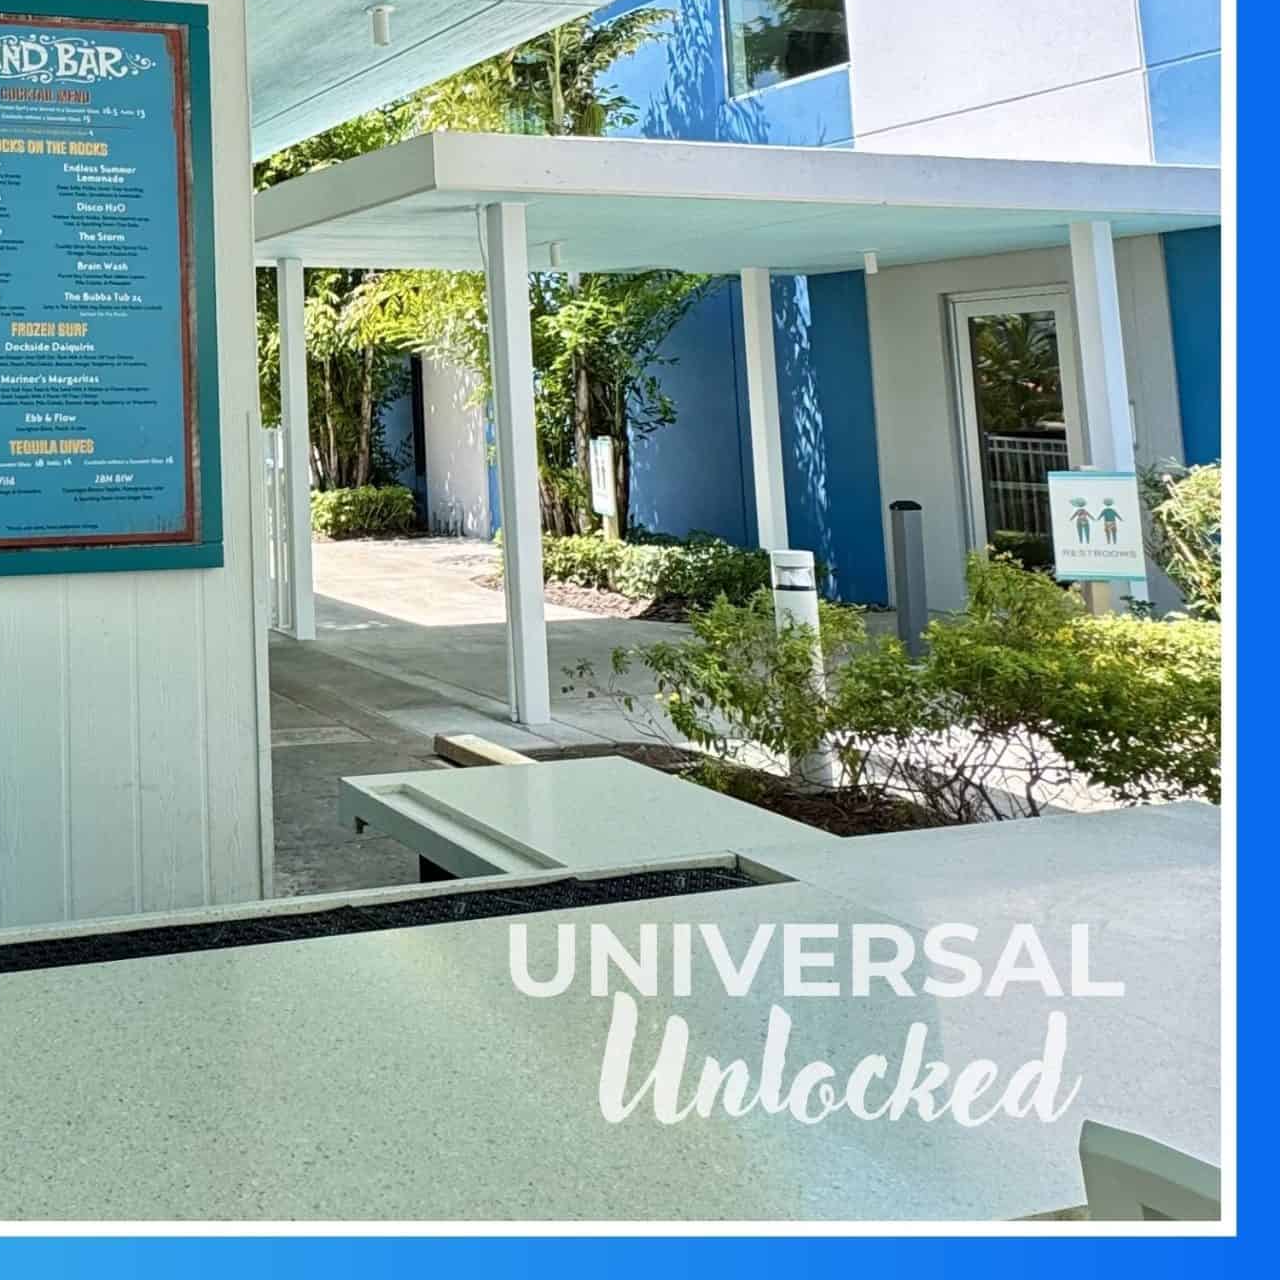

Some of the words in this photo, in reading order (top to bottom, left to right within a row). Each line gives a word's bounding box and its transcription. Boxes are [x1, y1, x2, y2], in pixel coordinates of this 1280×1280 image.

[54, 41, 127, 78] BAR
[28, 139, 44, 153] ON
[46, 140, 67, 154] THE
[70, 141, 108, 156] ROCKS
[63, 163, 98, 173] Endless
[100, 164, 136, 174] Summer
[77, 174, 124, 184] Lemonade
[77, 202, 104, 212] Disco
[79, 231, 96, 241] The
[98, 232, 125, 242] Storm
[77, 261, 102, 271] Brain
[104, 261, 128, 271] Wash
[64, 292, 81, 302] The
[83, 292, 112, 302] Bubba
[114, 292, 130, 302] Tub
[11, 322, 55, 337] FROZEN
[57, 322, 88, 337] SURF
[5, 342, 49, 352] Dockside
[52, 342, 95, 353] Daiquiris
[0, 374, 46, 384] Mariner's
[48, 375, 99, 386] Margaritas
[25, 413, 42, 422] Ebb
[45, 413, 52, 422] &
[54, 413, 76, 422] Flow
[8, 439, 58, 456] TEQUILA
[1062, 549, 1137, 559] RESTROOMS
